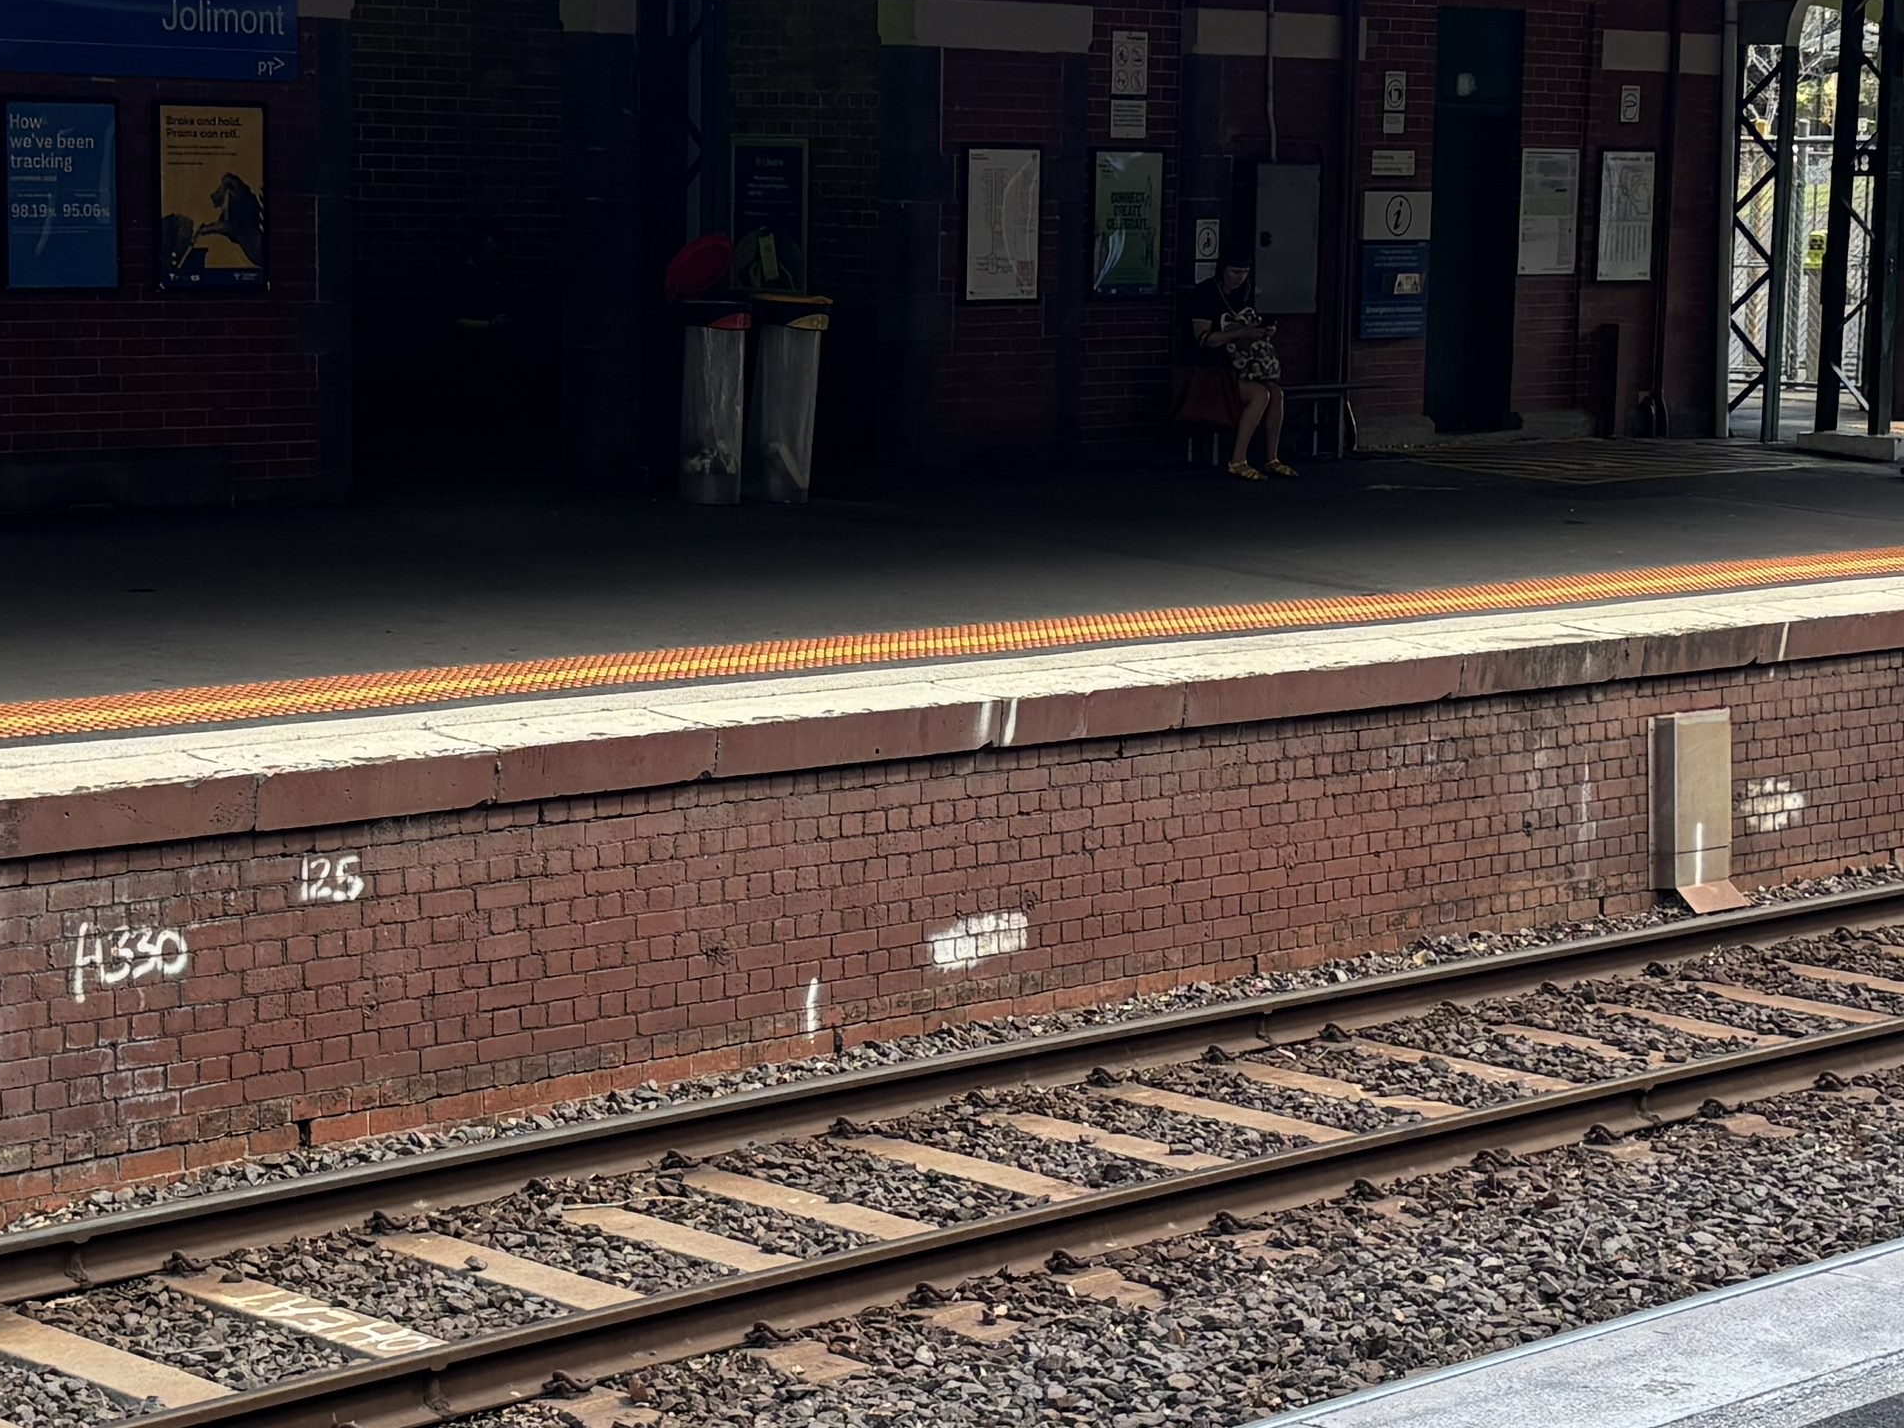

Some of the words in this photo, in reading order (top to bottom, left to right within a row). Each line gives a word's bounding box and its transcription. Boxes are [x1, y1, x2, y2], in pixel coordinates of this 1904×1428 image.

[9, 113, 43, 129] How
[10, 132, 53, 149] we've
[57, 132, 94, 149] been
[10, 152, 73, 173] tracking
[301, 855, 364, 901] 125
